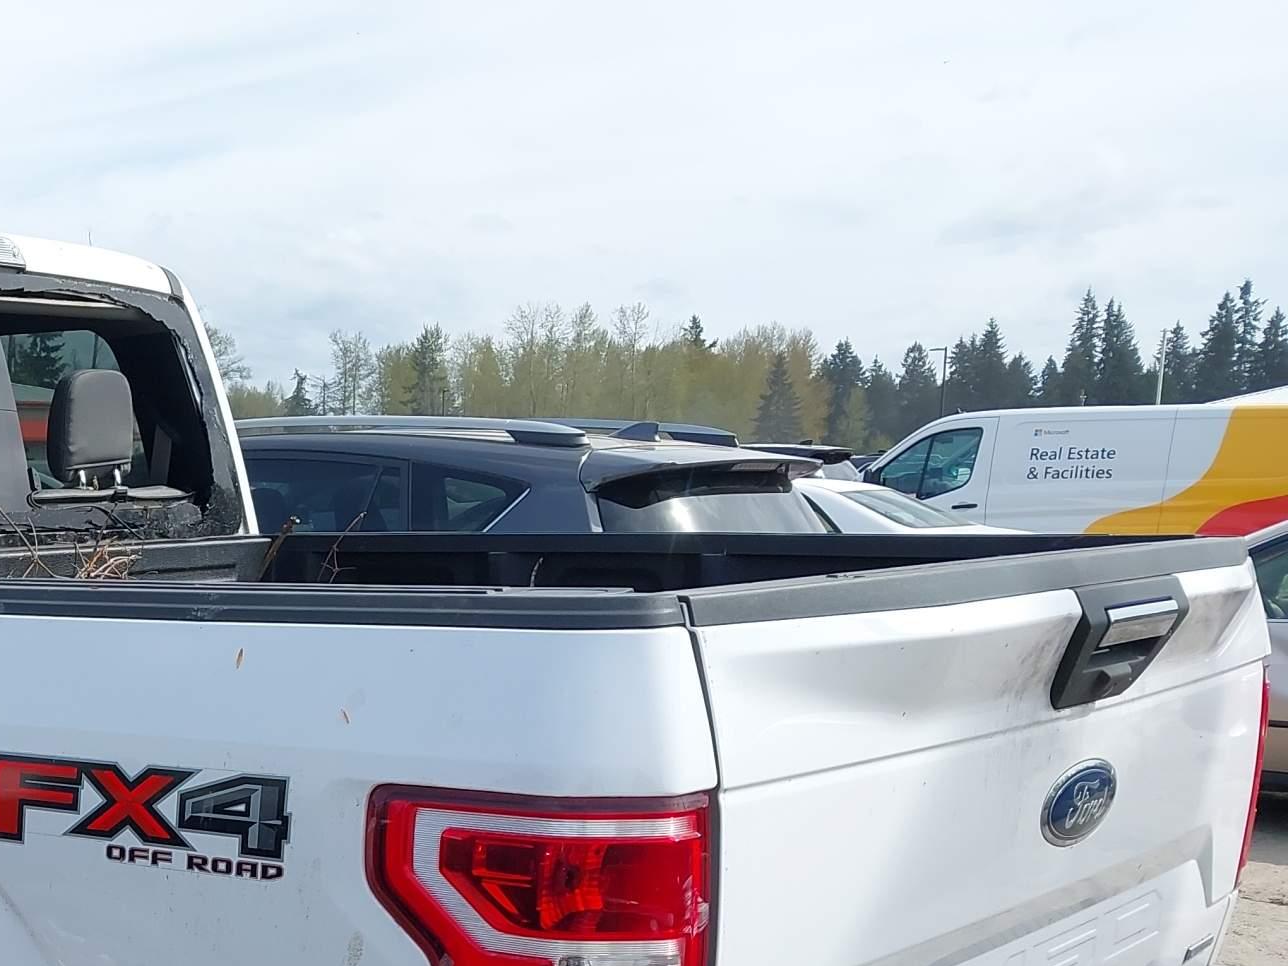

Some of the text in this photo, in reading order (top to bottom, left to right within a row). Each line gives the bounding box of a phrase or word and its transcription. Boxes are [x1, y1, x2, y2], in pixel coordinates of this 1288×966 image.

[1030, 446, 1116, 461] Real Estate
[1026, 464, 1113, 480] & Facilities
[106, 843, 285, 882] OFF ROAD
